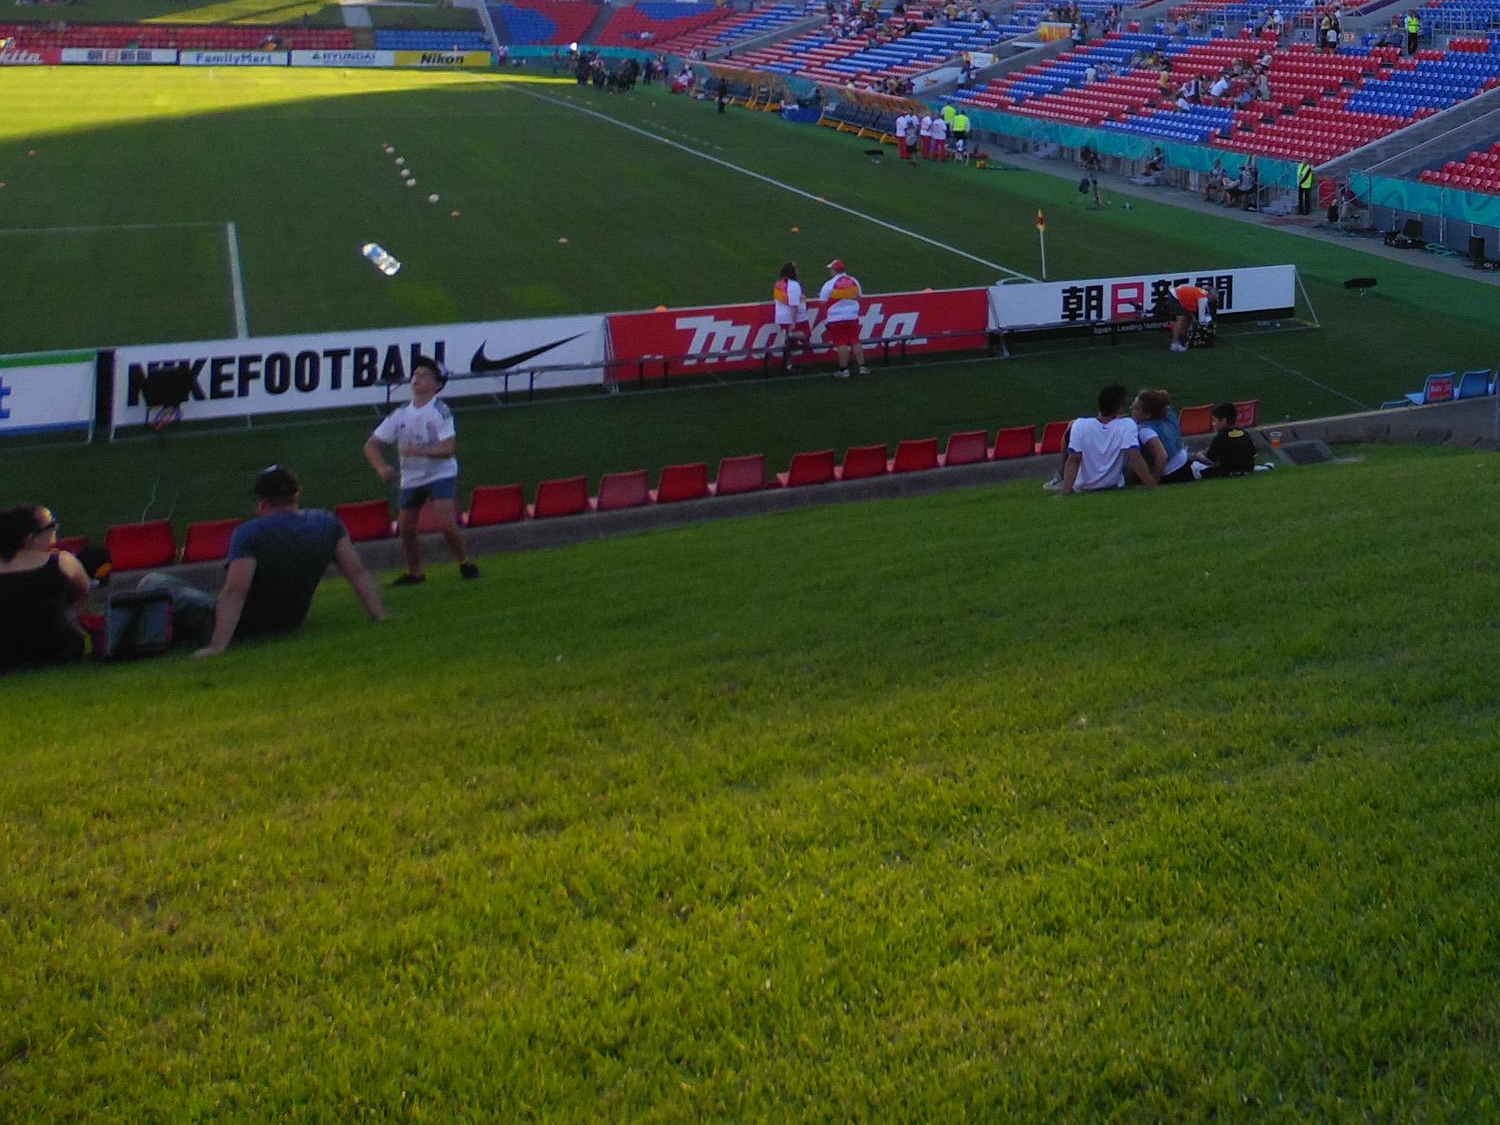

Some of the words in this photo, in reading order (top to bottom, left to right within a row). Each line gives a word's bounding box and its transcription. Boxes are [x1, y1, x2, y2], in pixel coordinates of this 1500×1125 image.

[196, 52, 273, 65] FamilyMart
[420, 52, 464, 64] Nikon
[127, 340, 448, 407] NKEFOOTBAL
